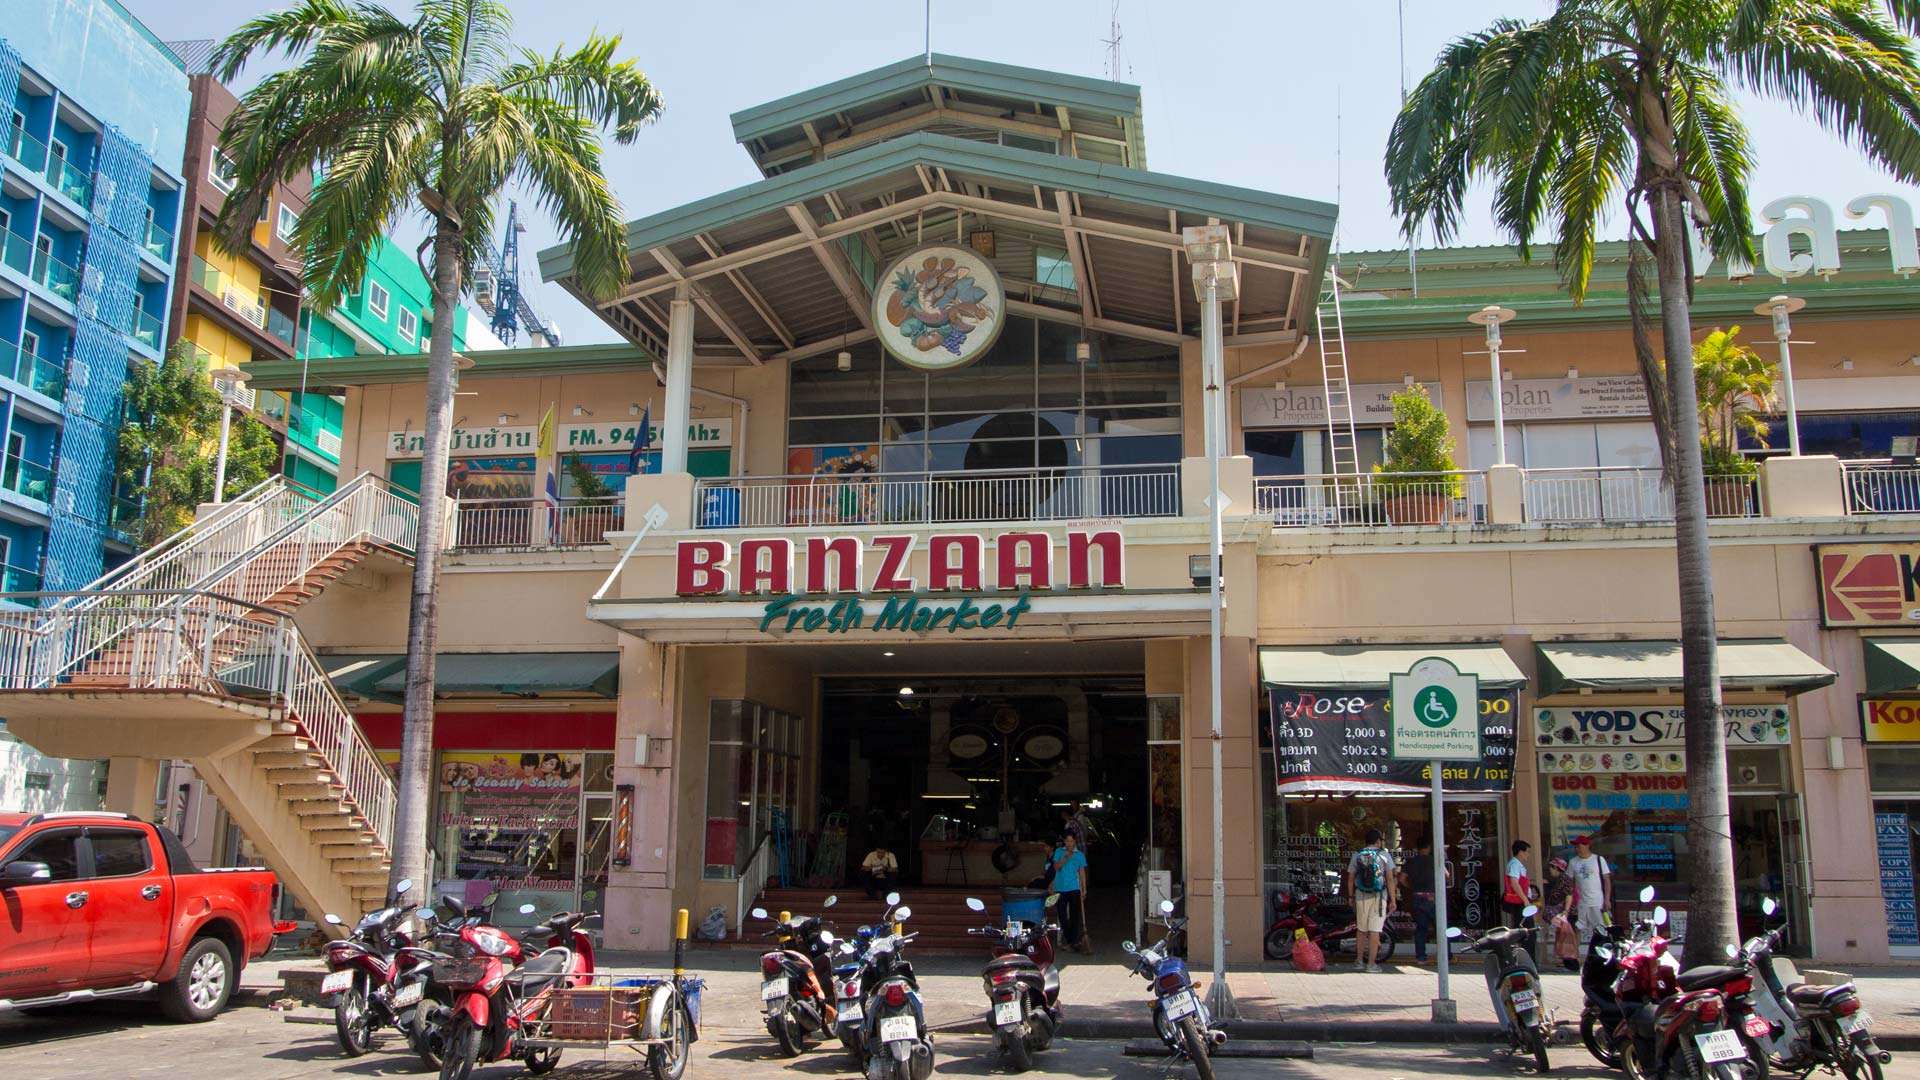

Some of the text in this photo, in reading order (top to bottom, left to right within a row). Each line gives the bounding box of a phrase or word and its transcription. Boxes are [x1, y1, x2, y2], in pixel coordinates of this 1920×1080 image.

[1250, 391, 1324, 419] Aplan
[568, 428, 602, 446] FM.
[760, 594, 1031, 634] Fresh Market
[1285, 693, 1366, 719] Rose
[1572, 710, 1637, 733] YOD
[1297, 727, 1314, 738] 3D
[1344, 727, 1375, 739] 2,000
[1399, 742, 1473, 751] Handicapped Parking
[1346, 763, 1377, 774] 3,000
[474, 776, 524, 790] Beauty
[529, 777, 569, 788] Salon
[1877, 825, 1906, 834] FAX
[1879, 858, 1910, 867] COPY
[1881, 869, 1912, 878] PRINT
[1884, 900, 1914, 910] SCAN
